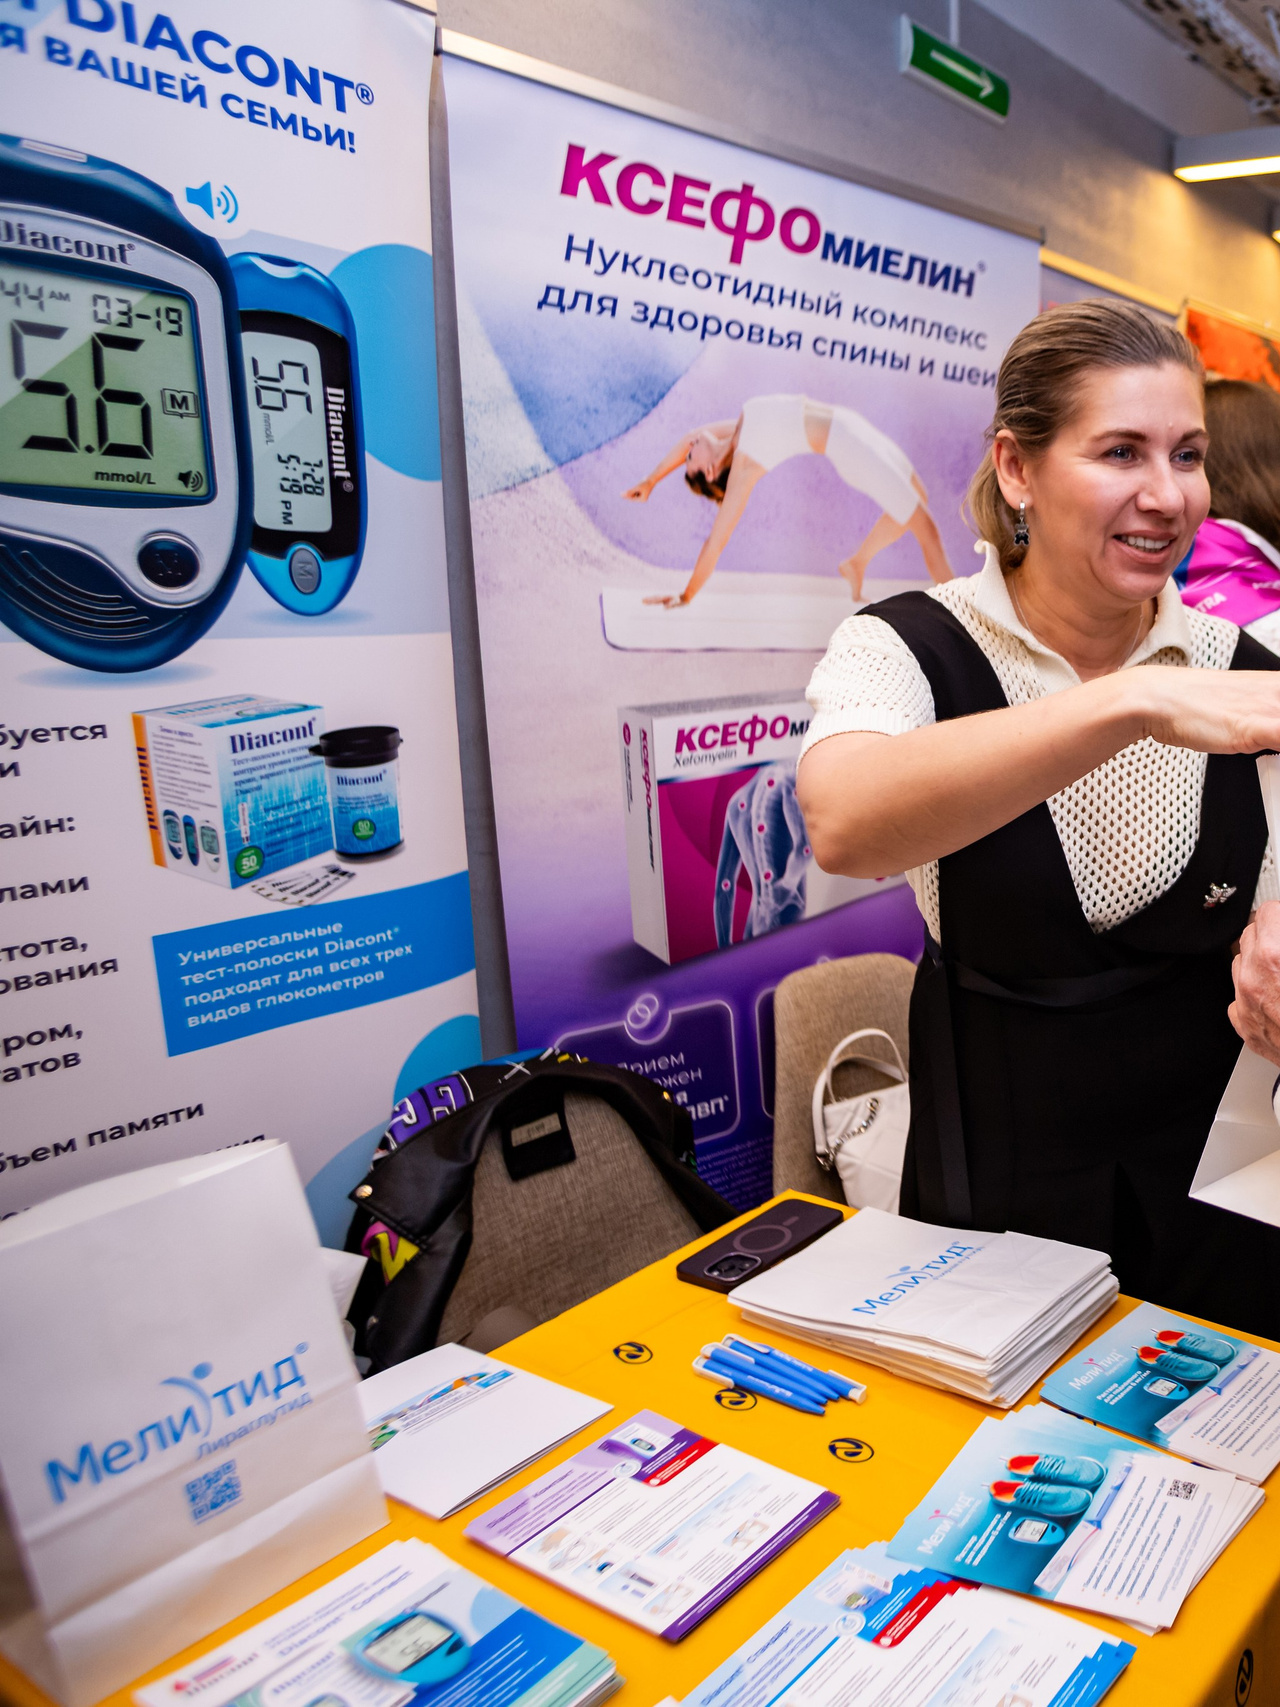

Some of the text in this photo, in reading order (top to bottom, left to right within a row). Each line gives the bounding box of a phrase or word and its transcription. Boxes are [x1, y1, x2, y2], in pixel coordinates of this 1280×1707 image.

[44, 35, 208, 109] ВАШЕЙ
[220, 93, 356, 154] СЕМЬИ!
[49, 289, 71, 303] AM
[92, 293, 184, 337] 03-19
[564, 233, 988, 352] Нуклеотидный комплекс
[537, 283, 998, 388] для здоровья спины и шеи
[11, 319, 154, 460] 5.6
[94, 469, 157, 486] mmol/L
[280, 500, 293, 526] PM
[242, 856, 257, 870] 50
[0, 935, 88, 962] тота,
[178, 922, 343, 967] Универсальные
[181, 946, 319, 987] тест-полоски
[185, 944, 413, 1007] подходят для всех трех
[188, 970, 385, 1028] видов глюкометров
[0, 1023, 84, 1056] ром,
[0, 1052, 82, 1083] атов
[88, 1103, 205, 1147] памяти
